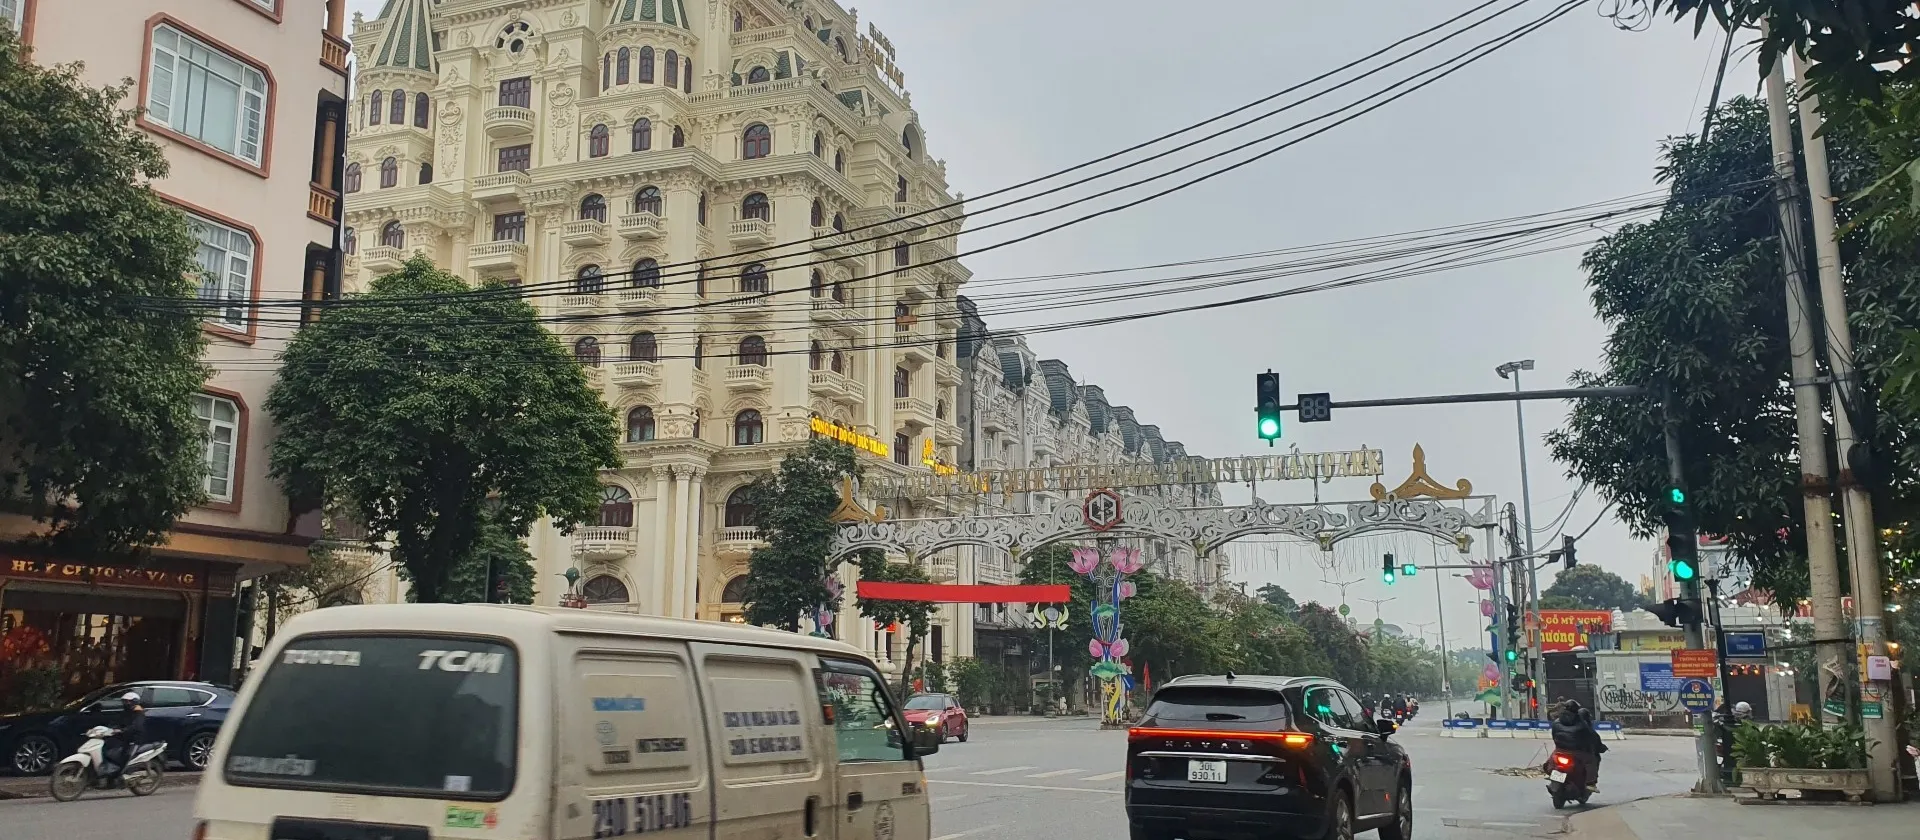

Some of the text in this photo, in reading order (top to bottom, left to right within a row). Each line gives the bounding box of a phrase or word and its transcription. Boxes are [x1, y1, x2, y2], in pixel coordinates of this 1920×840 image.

[1176, 457, 1238, 483] PARIS
[418, 650, 504, 673] TCM
[1166, 740, 1249, 749] HAVAL
[1199, 762, 1215, 771] 30L
[1191, 771, 1221, 781] 930.11
